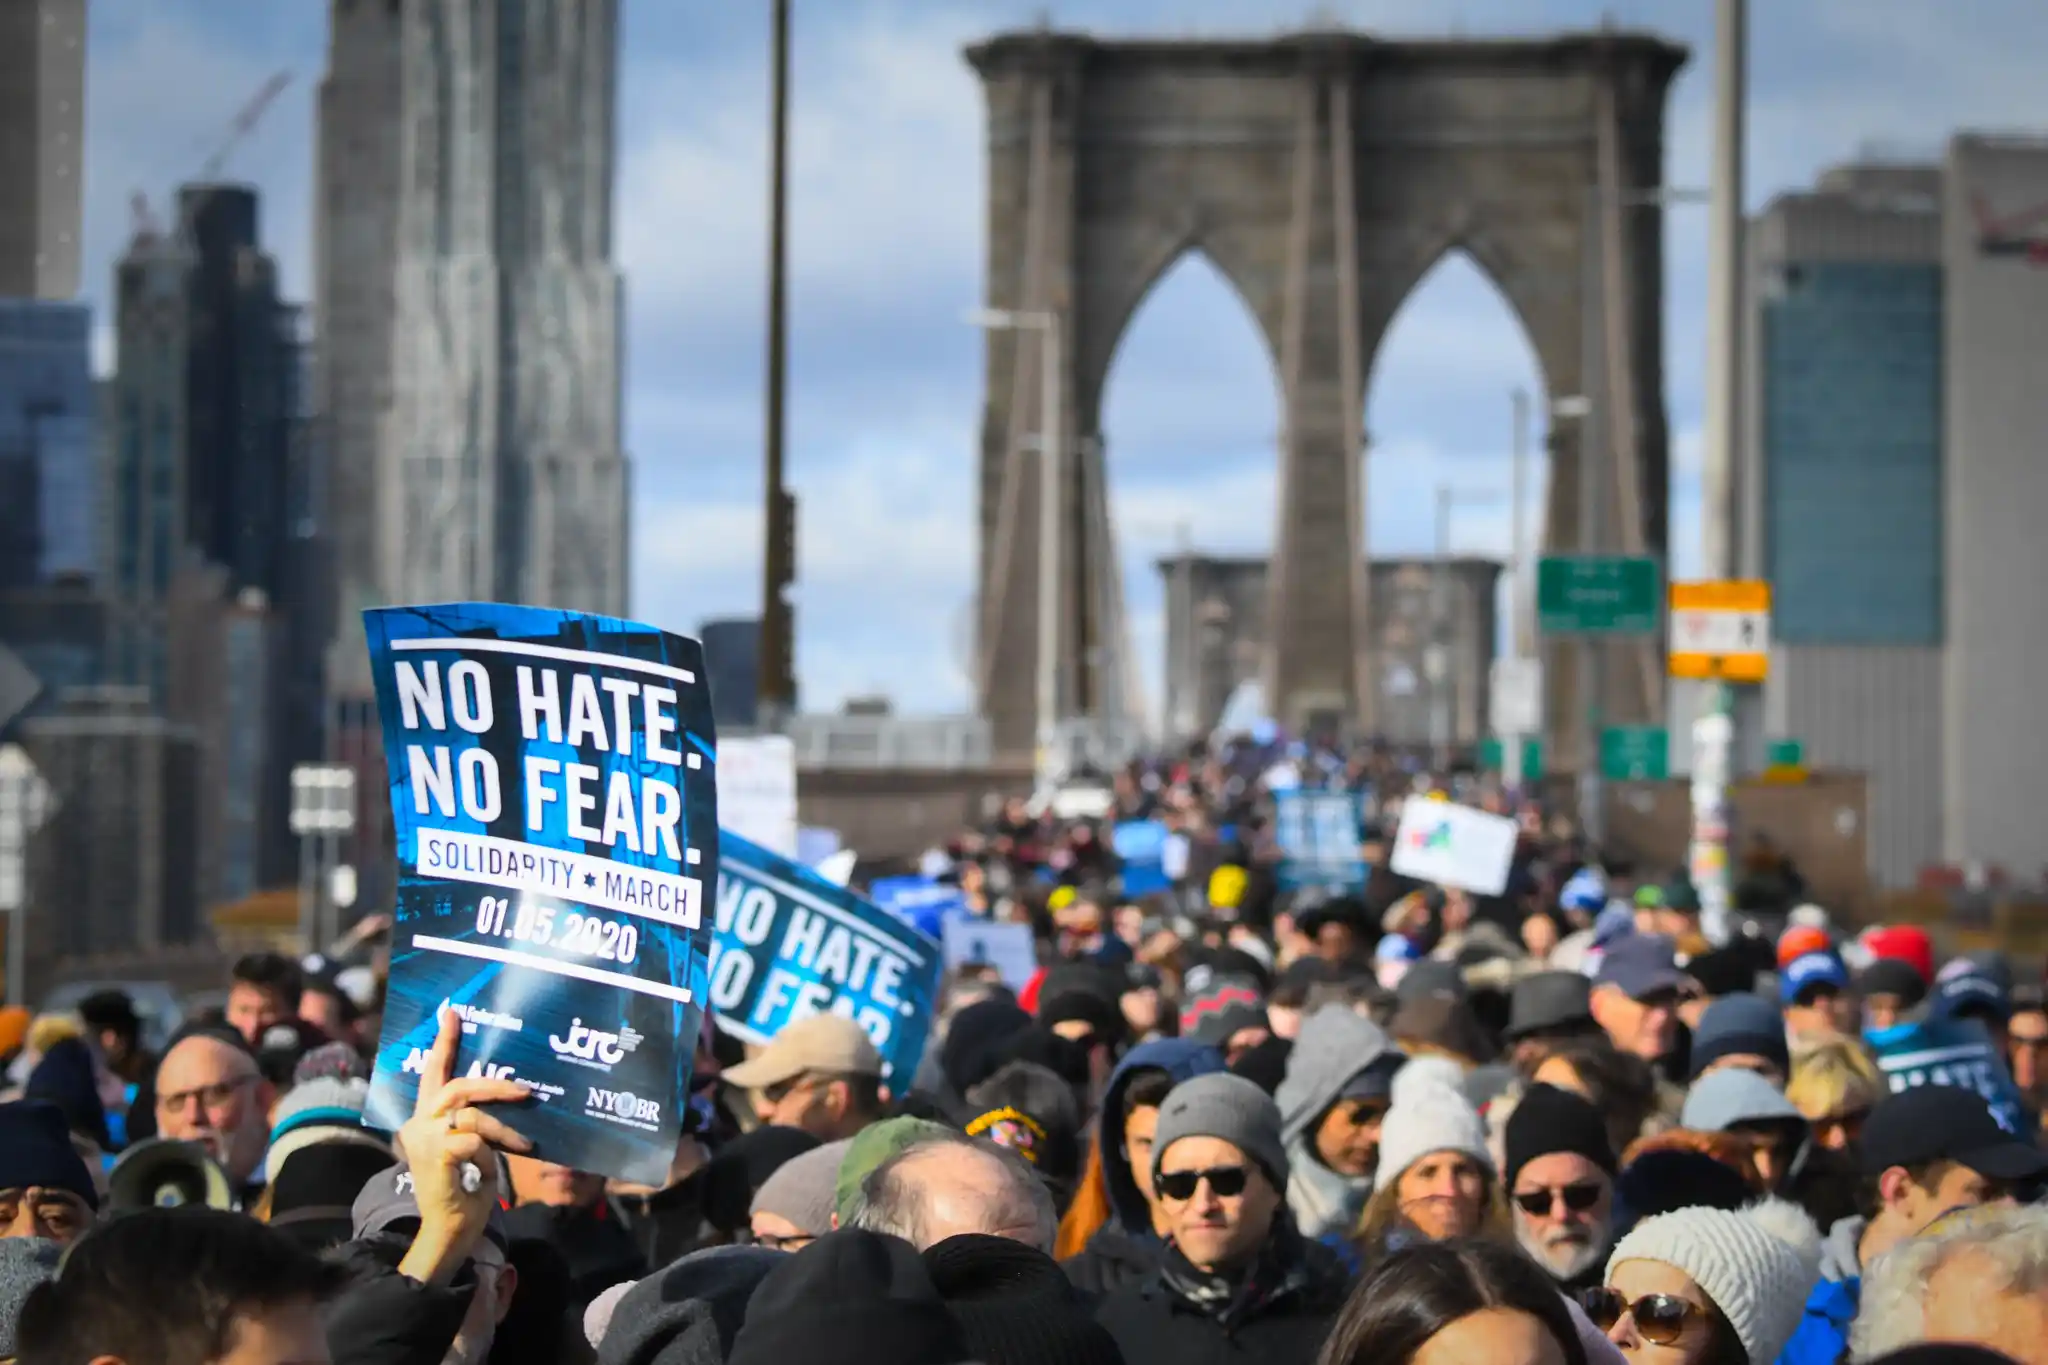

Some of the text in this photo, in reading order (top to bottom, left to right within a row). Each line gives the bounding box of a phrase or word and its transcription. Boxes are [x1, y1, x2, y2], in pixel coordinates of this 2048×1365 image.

[394, 659, 701, 770] NO HATE.
[407, 744, 502, 823] NO
[523, 755, 701, 865] FEAR.
[428, 839, 688, 917] SOLIDARITY MARCH
[475, 896, 638, 964] 01.05.2020
[780, 905, 915, 1017] HATE.
